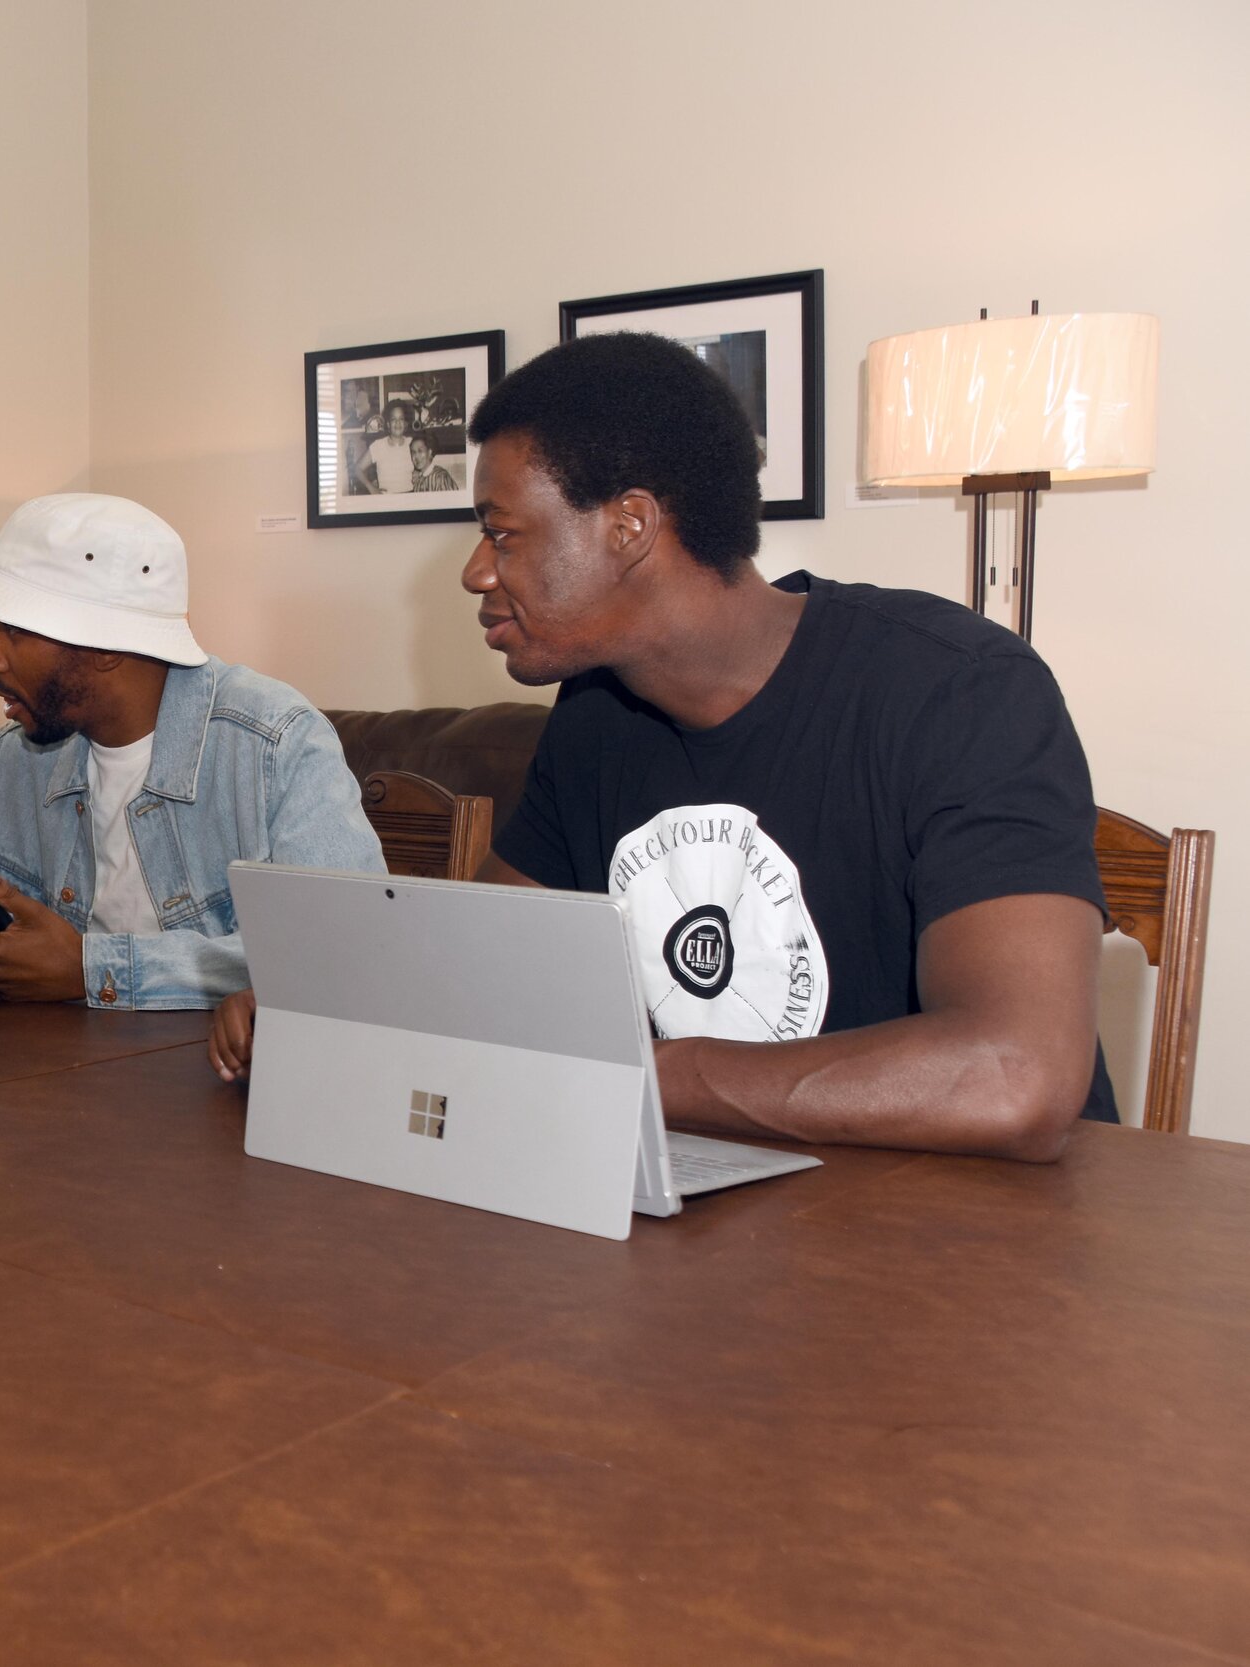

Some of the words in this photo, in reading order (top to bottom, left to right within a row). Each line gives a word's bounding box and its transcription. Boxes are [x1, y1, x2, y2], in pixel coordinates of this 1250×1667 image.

[614, 831, 669, 892] CHECK
[668, 818, 733, 848] YOUR
[738, 825, 795, 908] BCKET
[686, 939, 720, 965] ELLA
[690, 961, 717, 971] PROJECT
[763, 954, 812, 1042] SINESS
